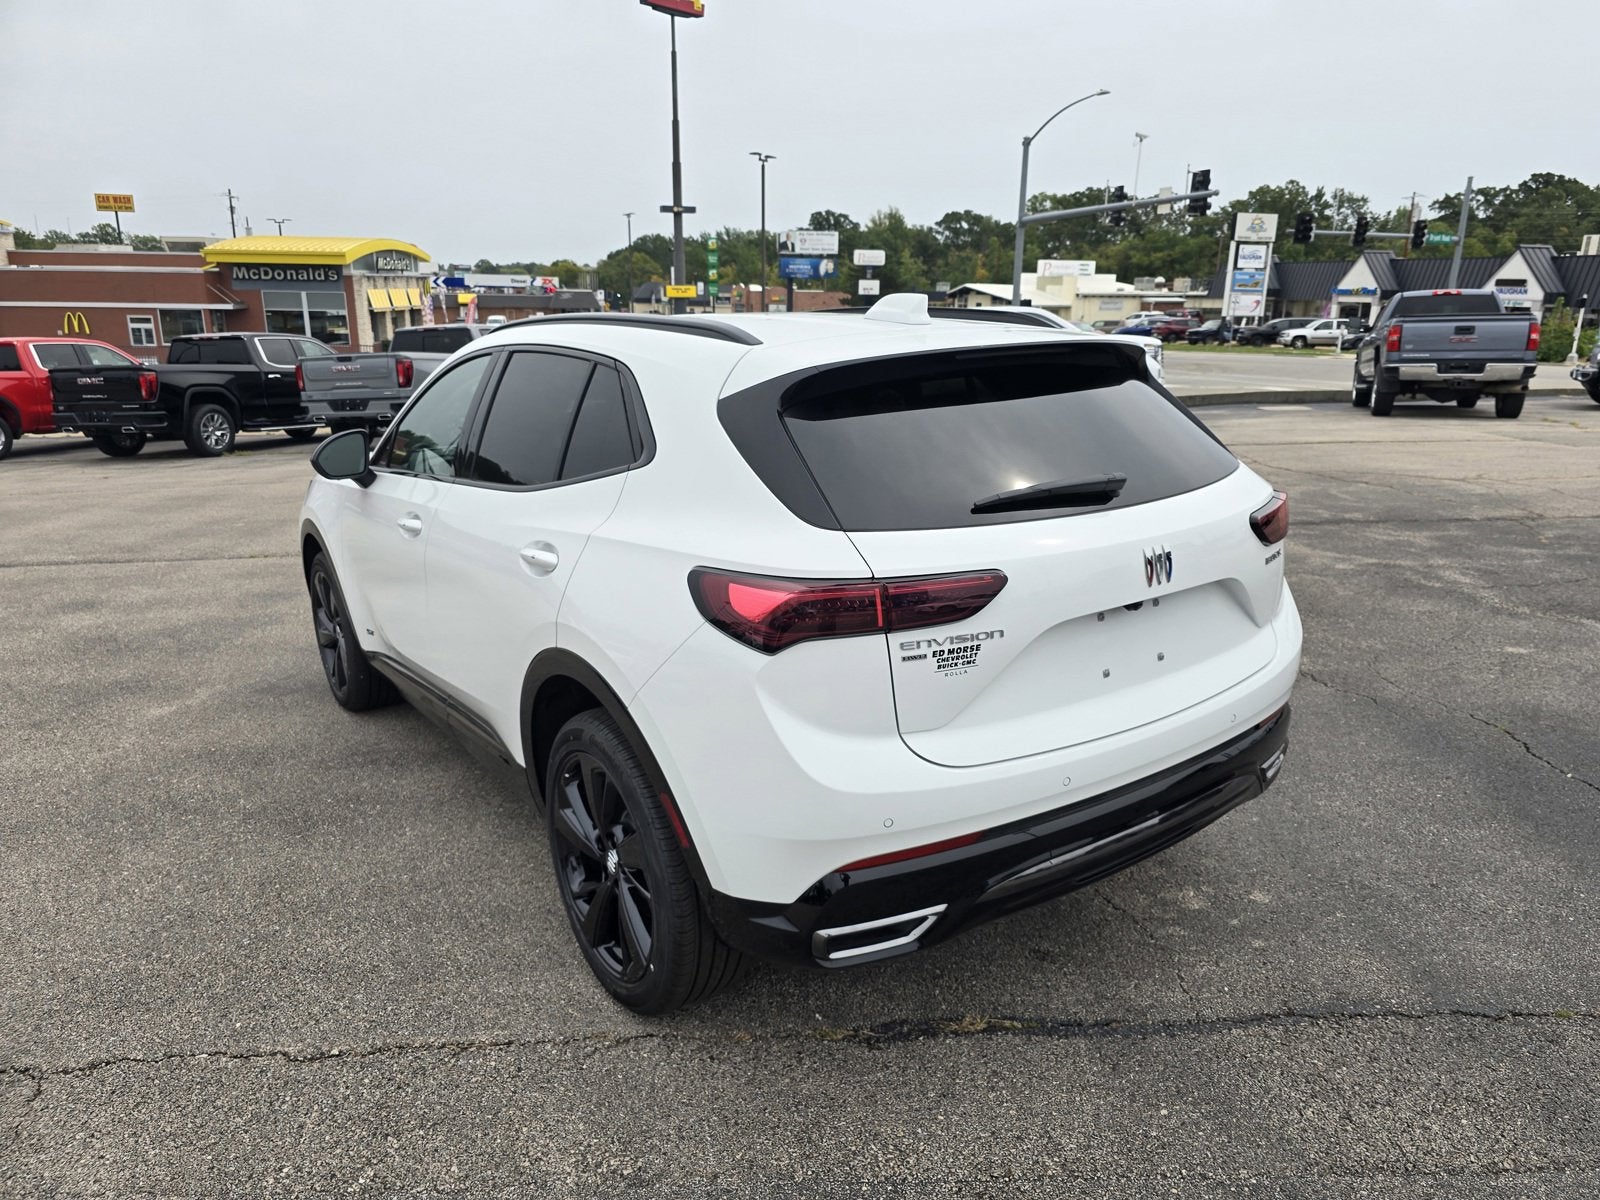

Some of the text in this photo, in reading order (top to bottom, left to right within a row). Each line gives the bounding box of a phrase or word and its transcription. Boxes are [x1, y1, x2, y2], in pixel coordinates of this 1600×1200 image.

[97, 195, 132, 205] CAR WASH
[377, 257, 411, 270] McDonald's
[232, 266, 338, 280] McDonald's
[899, 629, 1004, 651] ENVISION
[932, 644, 981, 658] ED MORSE
[936, 652, 978, 664] CHEVROLET
[944, 669, 968, 678] ROLLA
